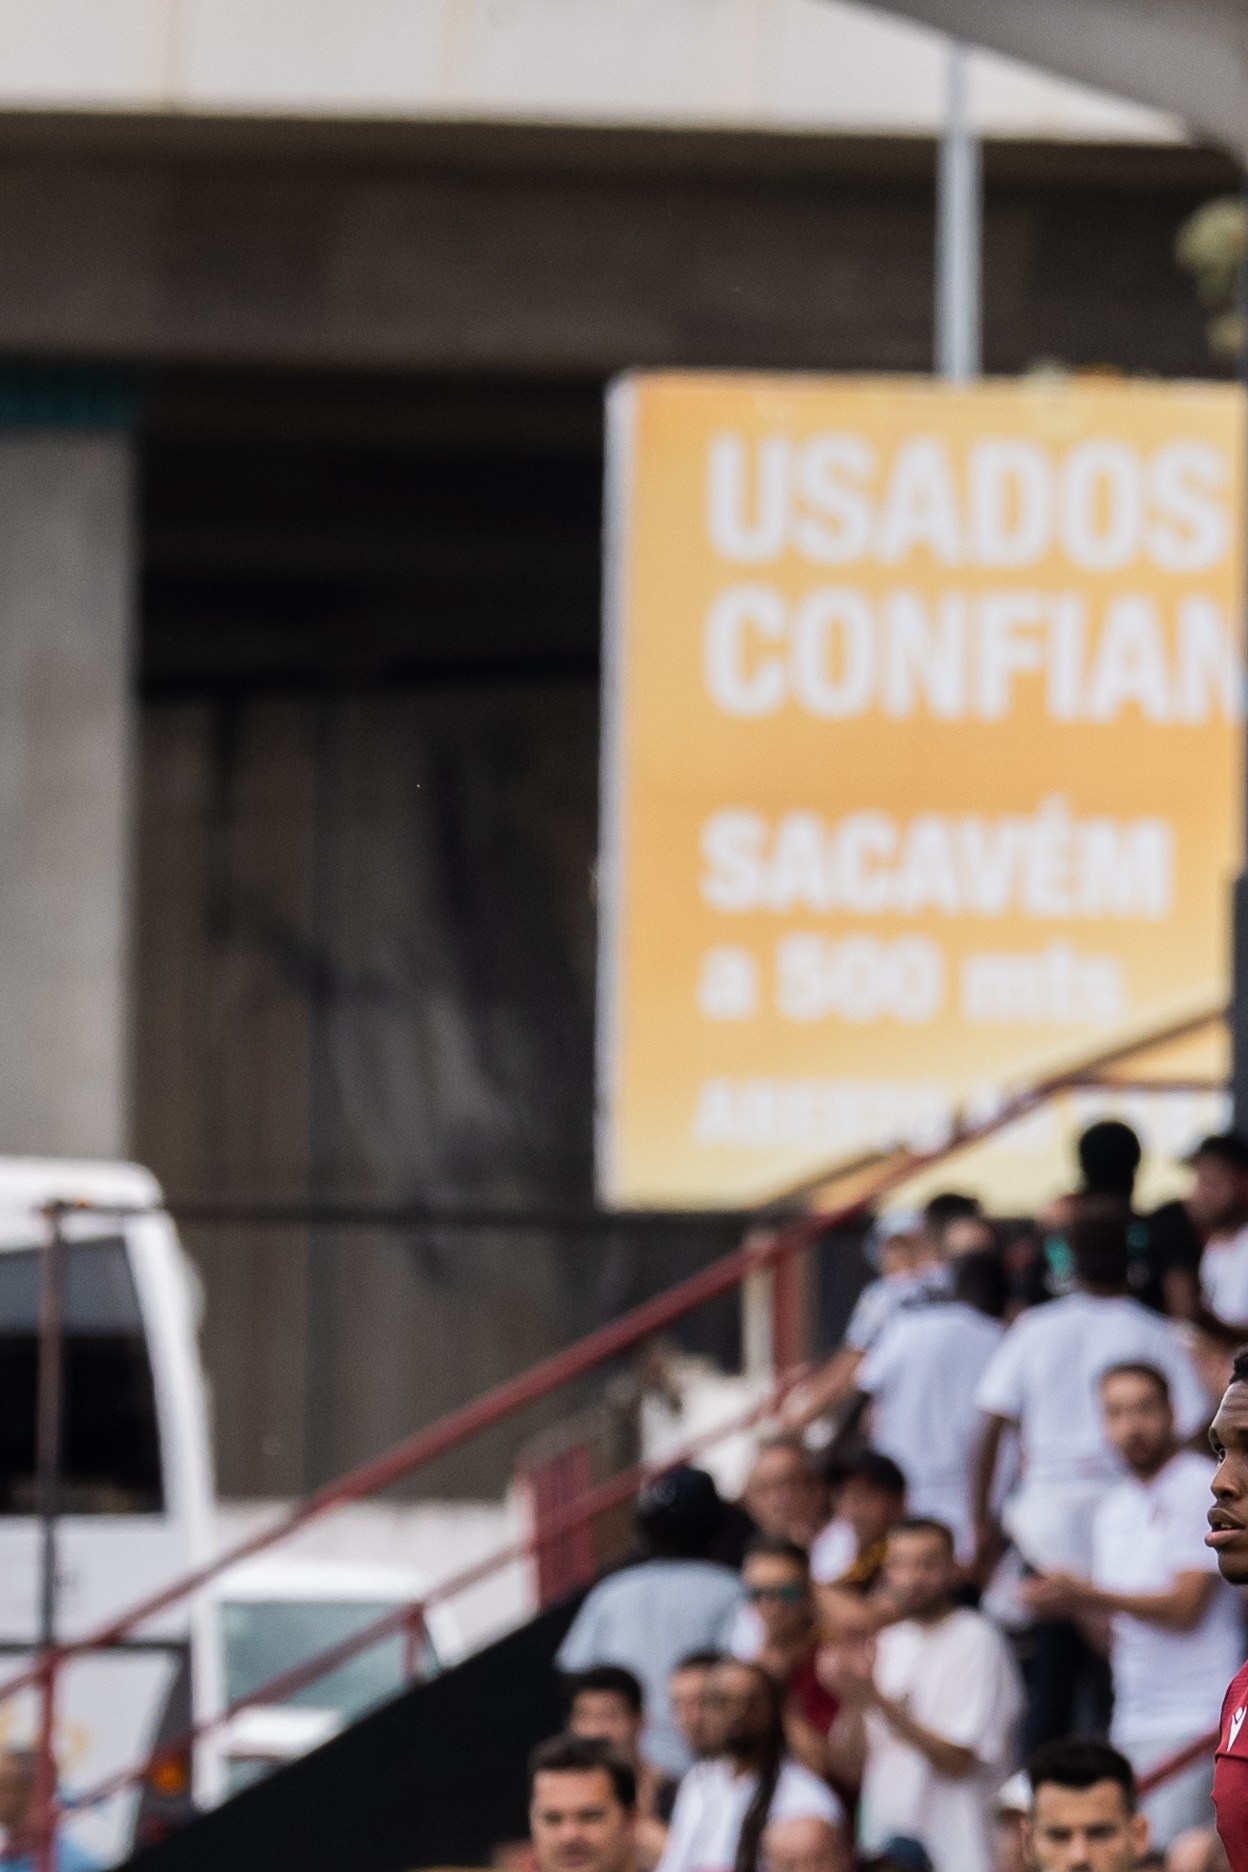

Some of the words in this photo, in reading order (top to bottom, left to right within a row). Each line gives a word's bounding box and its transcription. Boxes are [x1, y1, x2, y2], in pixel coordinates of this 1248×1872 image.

[705, 433, 1228, 571] USADOS
[699, 794, 1171, 919] SACAVÉM
[696, 944, 757, 1021] a
[774, 930, 946, 1024] 500
